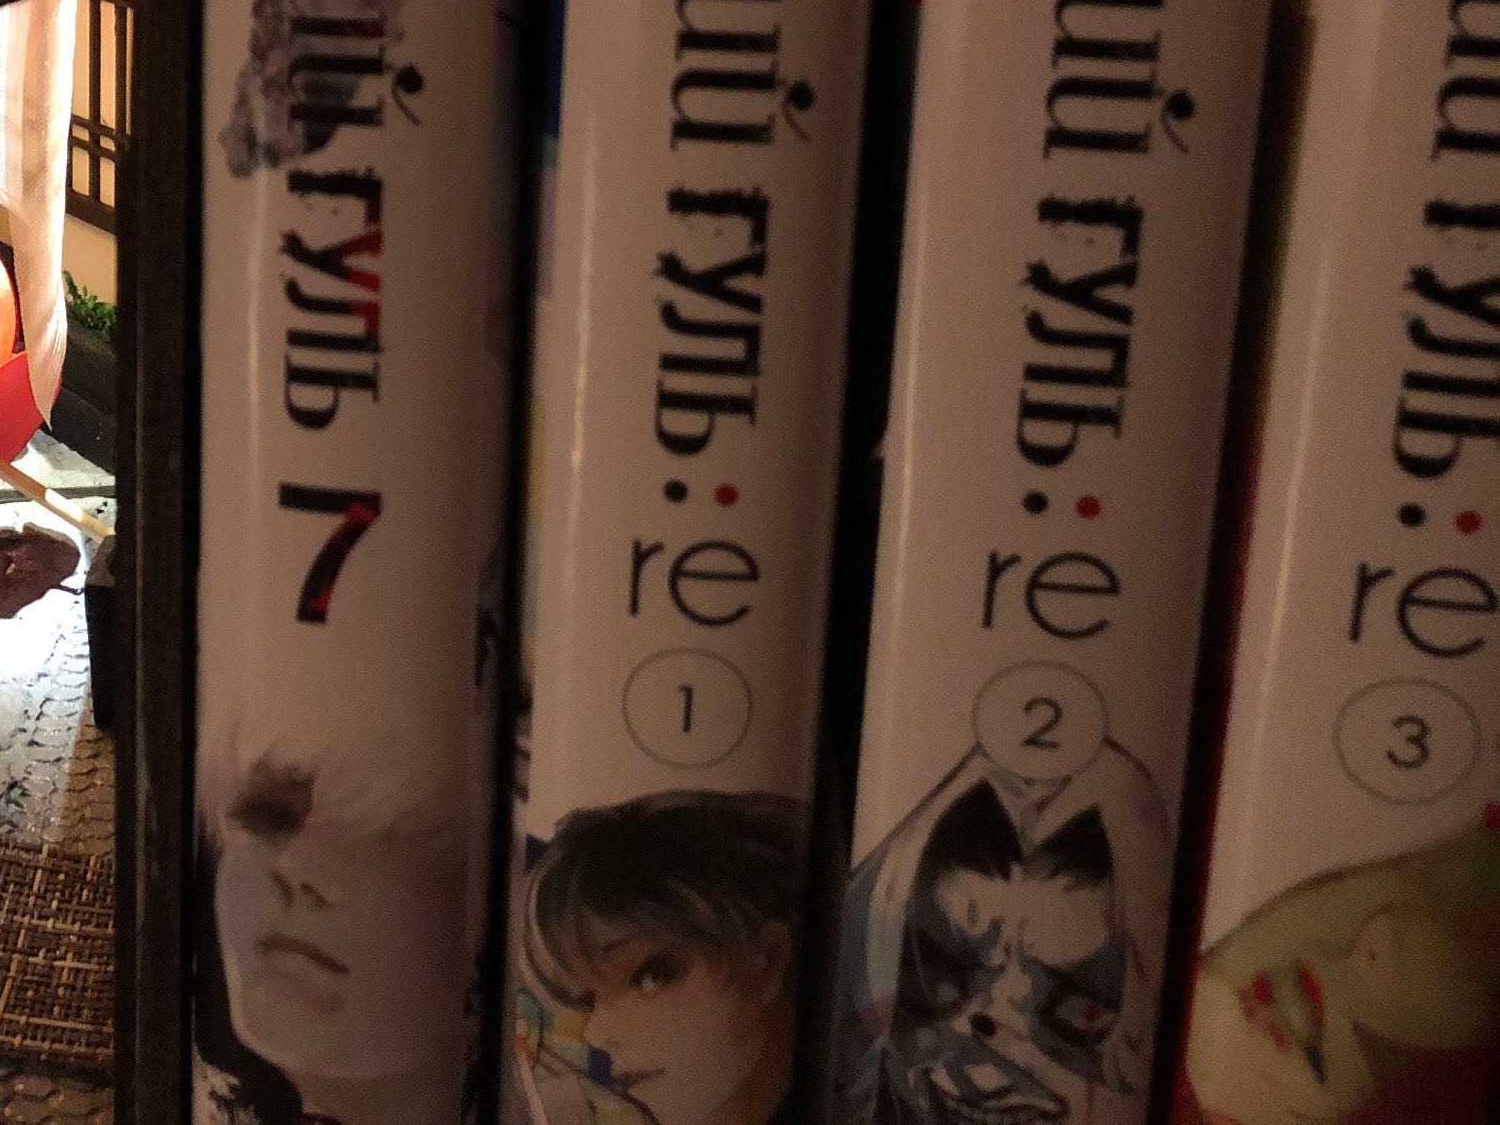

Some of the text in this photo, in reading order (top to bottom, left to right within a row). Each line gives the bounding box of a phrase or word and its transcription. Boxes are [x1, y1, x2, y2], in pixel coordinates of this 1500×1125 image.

[277, 481, 382, 625] 7
[630, 538, 760, 627] re
[981, 550, 1121, 640] re
[1348, 562, 1500, 657] re
[677, 684, 694, 734] 1
[1022, 696, 1064, 750] 2
[1386, 715, 1432, 770] 3
